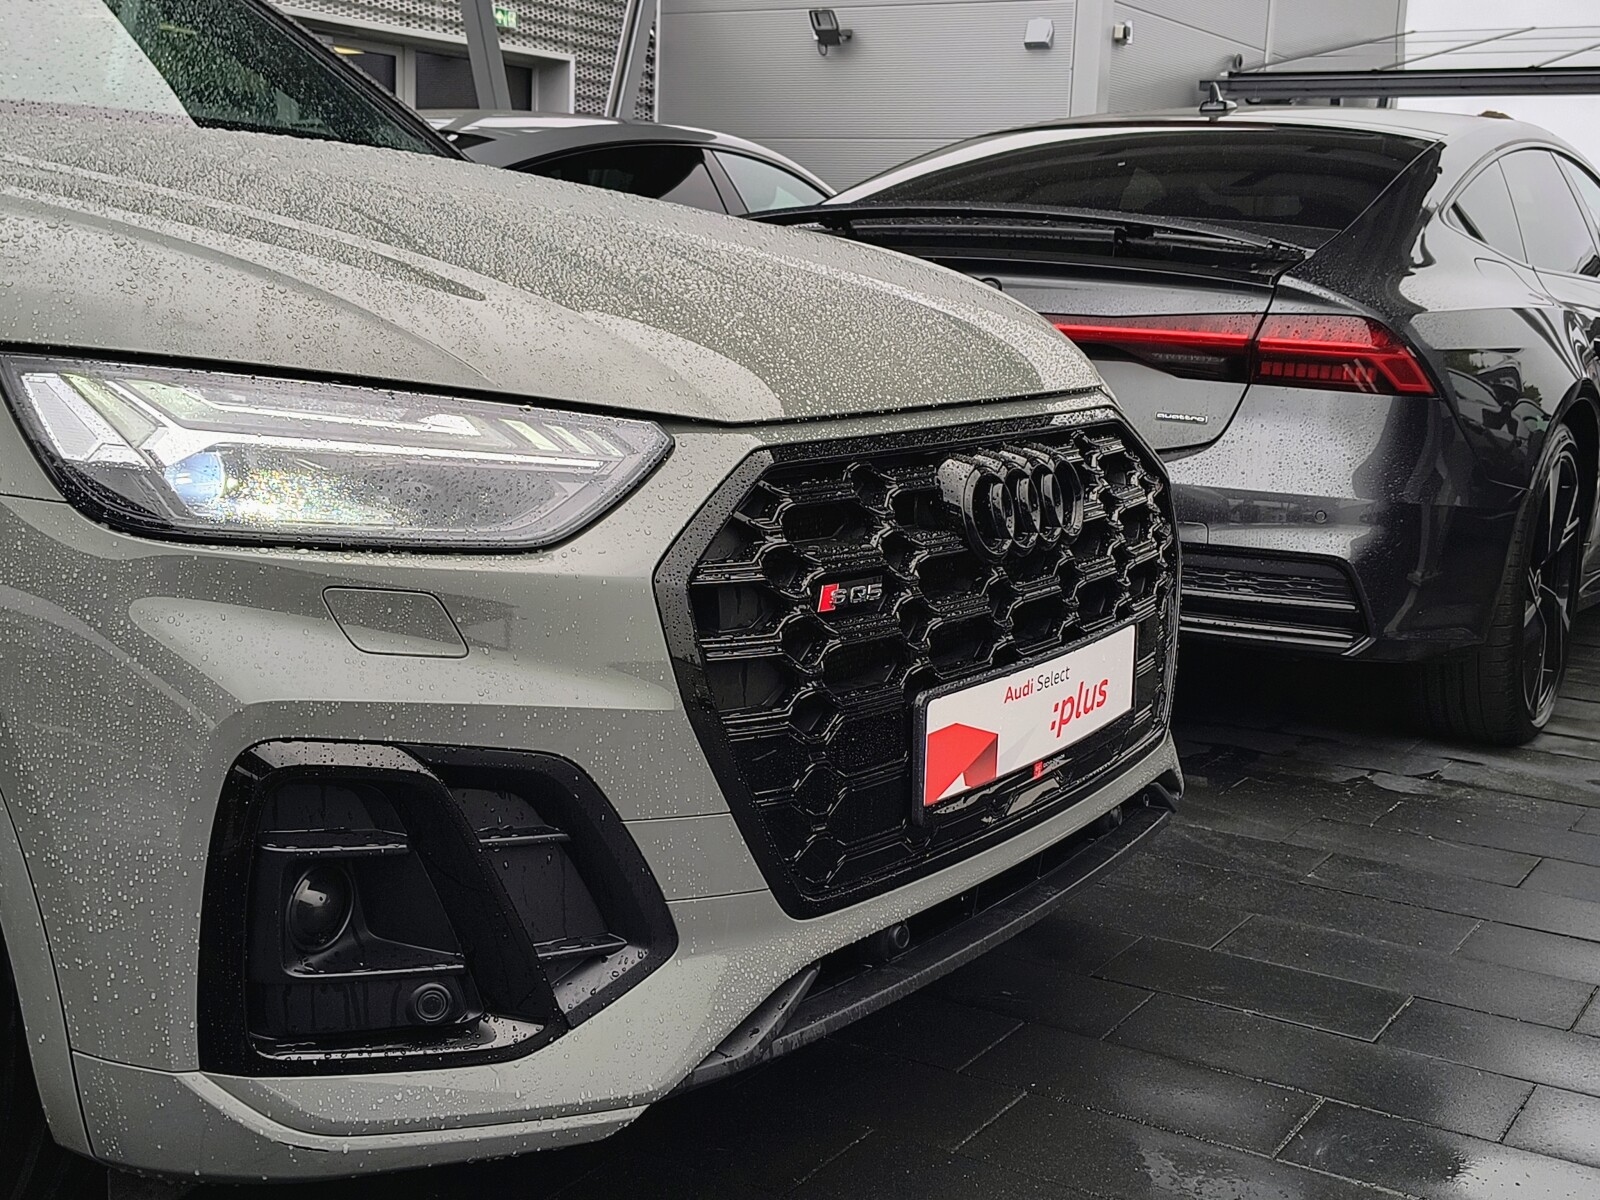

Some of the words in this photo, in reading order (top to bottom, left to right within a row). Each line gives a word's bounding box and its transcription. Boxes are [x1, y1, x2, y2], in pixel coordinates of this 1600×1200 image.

[1156, 412, 1206, 422] quattro
[1003, 678, 1034, 704] Audi
[1036, 666, 1070, 692] Select
